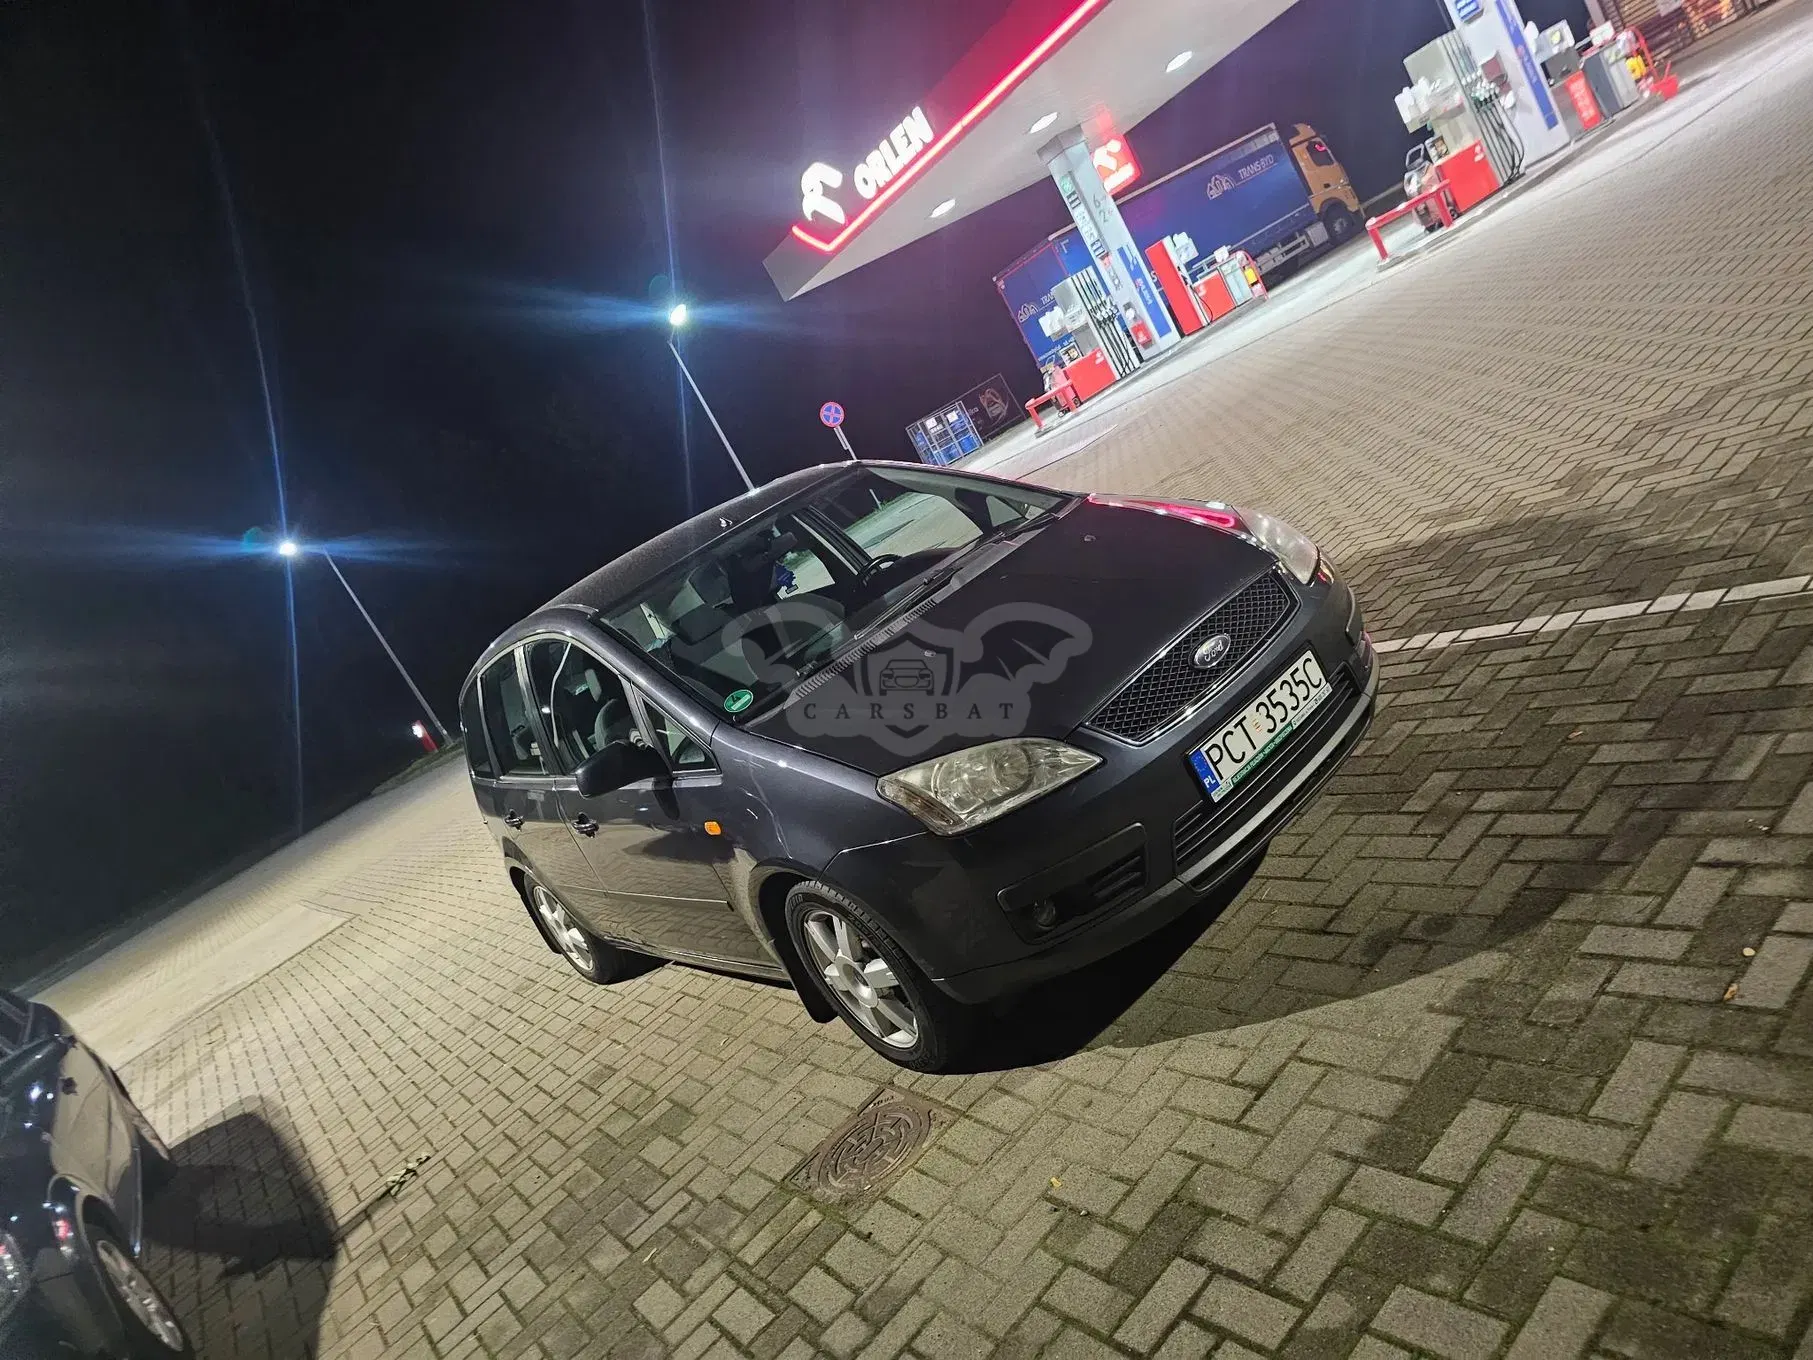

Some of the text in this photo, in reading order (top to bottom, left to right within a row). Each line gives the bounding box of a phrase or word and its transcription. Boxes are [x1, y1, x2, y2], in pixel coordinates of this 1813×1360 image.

[854, 106, 934, 199] ORLEN
[1204, 638, 1224, 662] Ford
[1205, 716, 1257, 781] PCT
[1256, 657, 1322, 734] 3535C
[1203, 776, 1216, 789] PL
